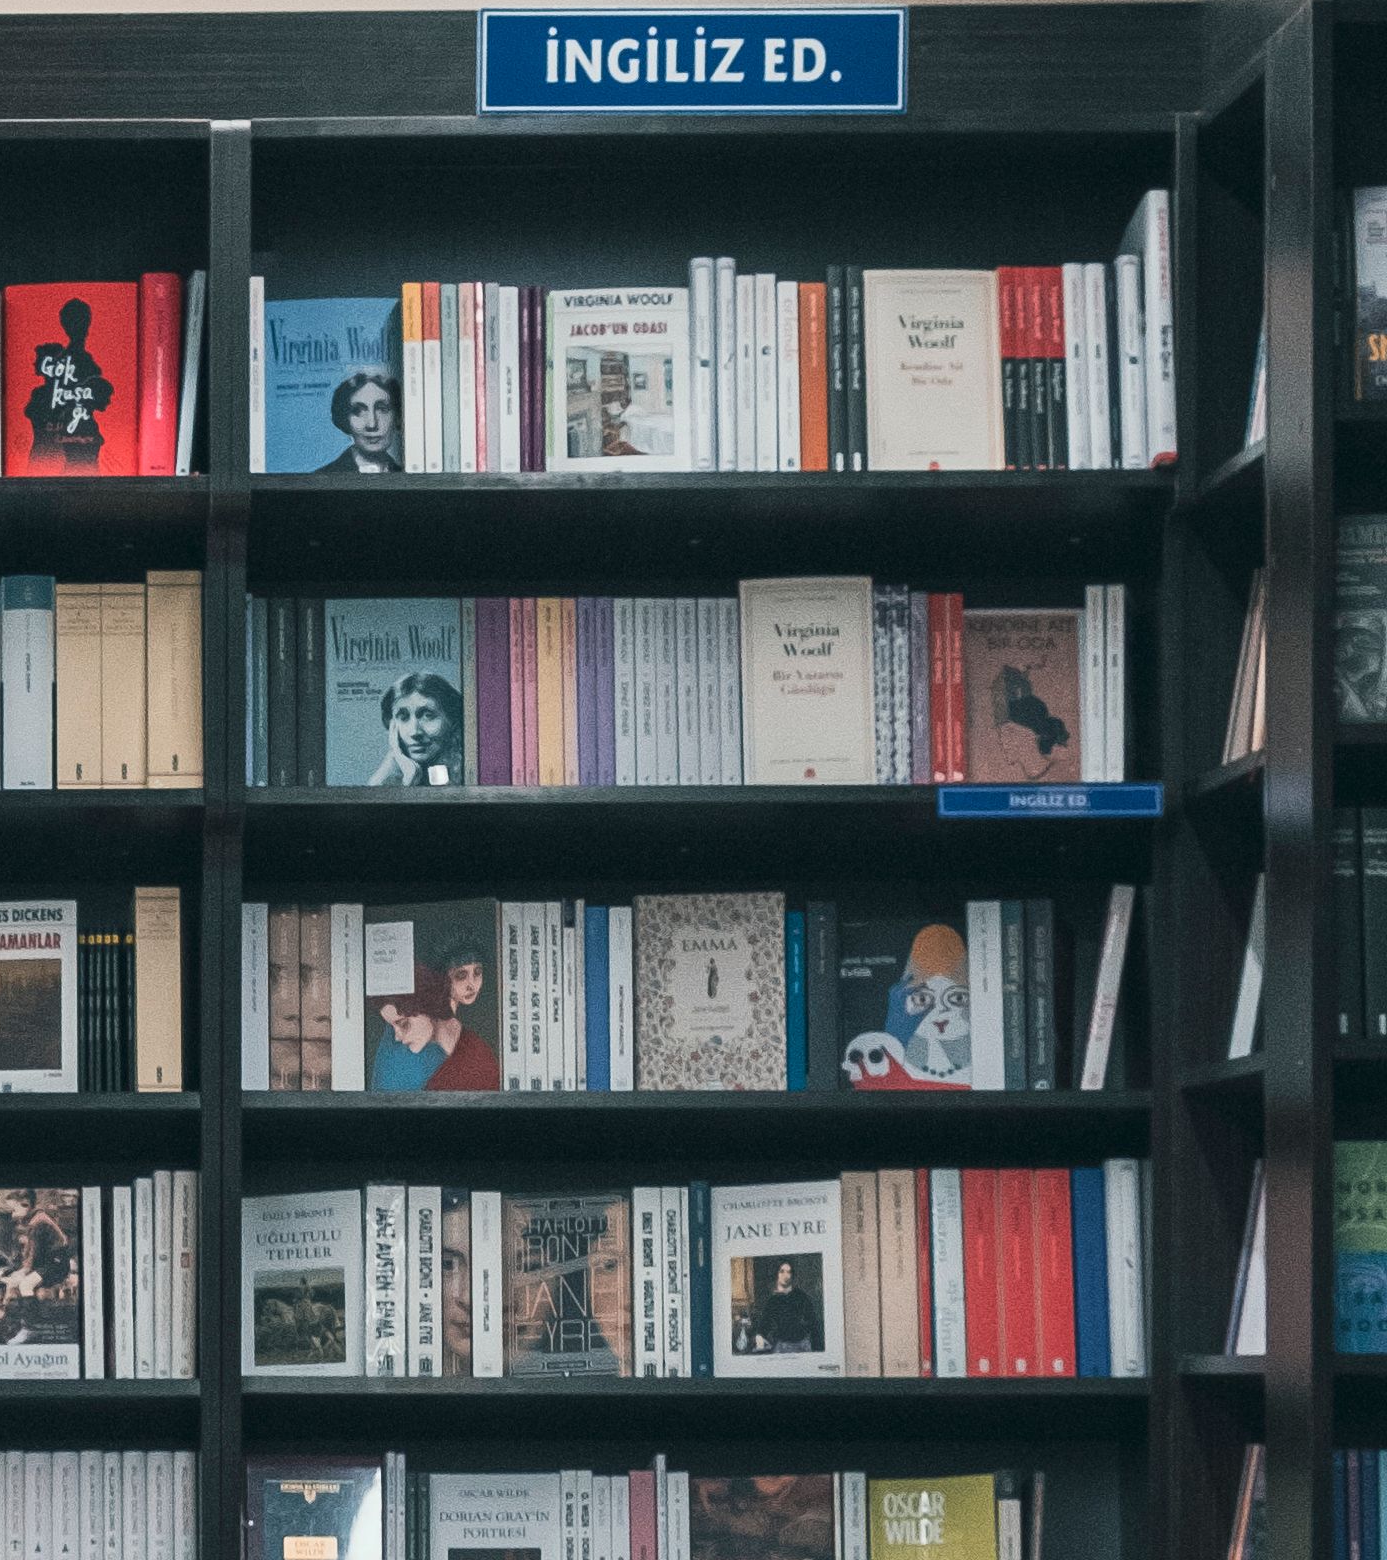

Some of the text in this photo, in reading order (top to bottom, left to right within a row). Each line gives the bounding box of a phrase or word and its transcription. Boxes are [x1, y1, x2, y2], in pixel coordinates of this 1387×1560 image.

[545, 26, 843, 83] İNGİLİZ ED.
[563, 292, 674, 307] VIRGINIA WOOLF
[569, 321, 669, 337] JACOB'UN ODASI
[898, 313, 965, 334] Virginia
[268, 317, 400, 365] Virginia Woolf
[907, 333, 957, 352] Woolf
[40, 355, 79, 383] Gök
[51, 383, 94, 410] kuşa
[329, 614, 457, 663] Virginia Woolf
[773, 622, 841, 640] Virginia
[782, 641, 834, 658] Woolf
[1009, 791, 1065, 808] İNGİLİZ
[11, 907, 64, 922] DICKENS
[681, 936, 739, 954] EMMA
[255, 1226, 342, 1247] UĞULTULU
[725, 1218, 827, 1243] JANE EYRE
[265, 1246, 333, 1261] TEPELER
[13, 1351, 69, 1369] Ayağım
[459, 1487, 493, 1499] OSCAR
[883, 1489, 946, 1519] OSCAR
[439, 1508, 550, 1525] DORIAN GRAY'İN
[462, 1523, 527, 1540] PORTRESİ
[883, 1518, 945, 1546] WILDE
